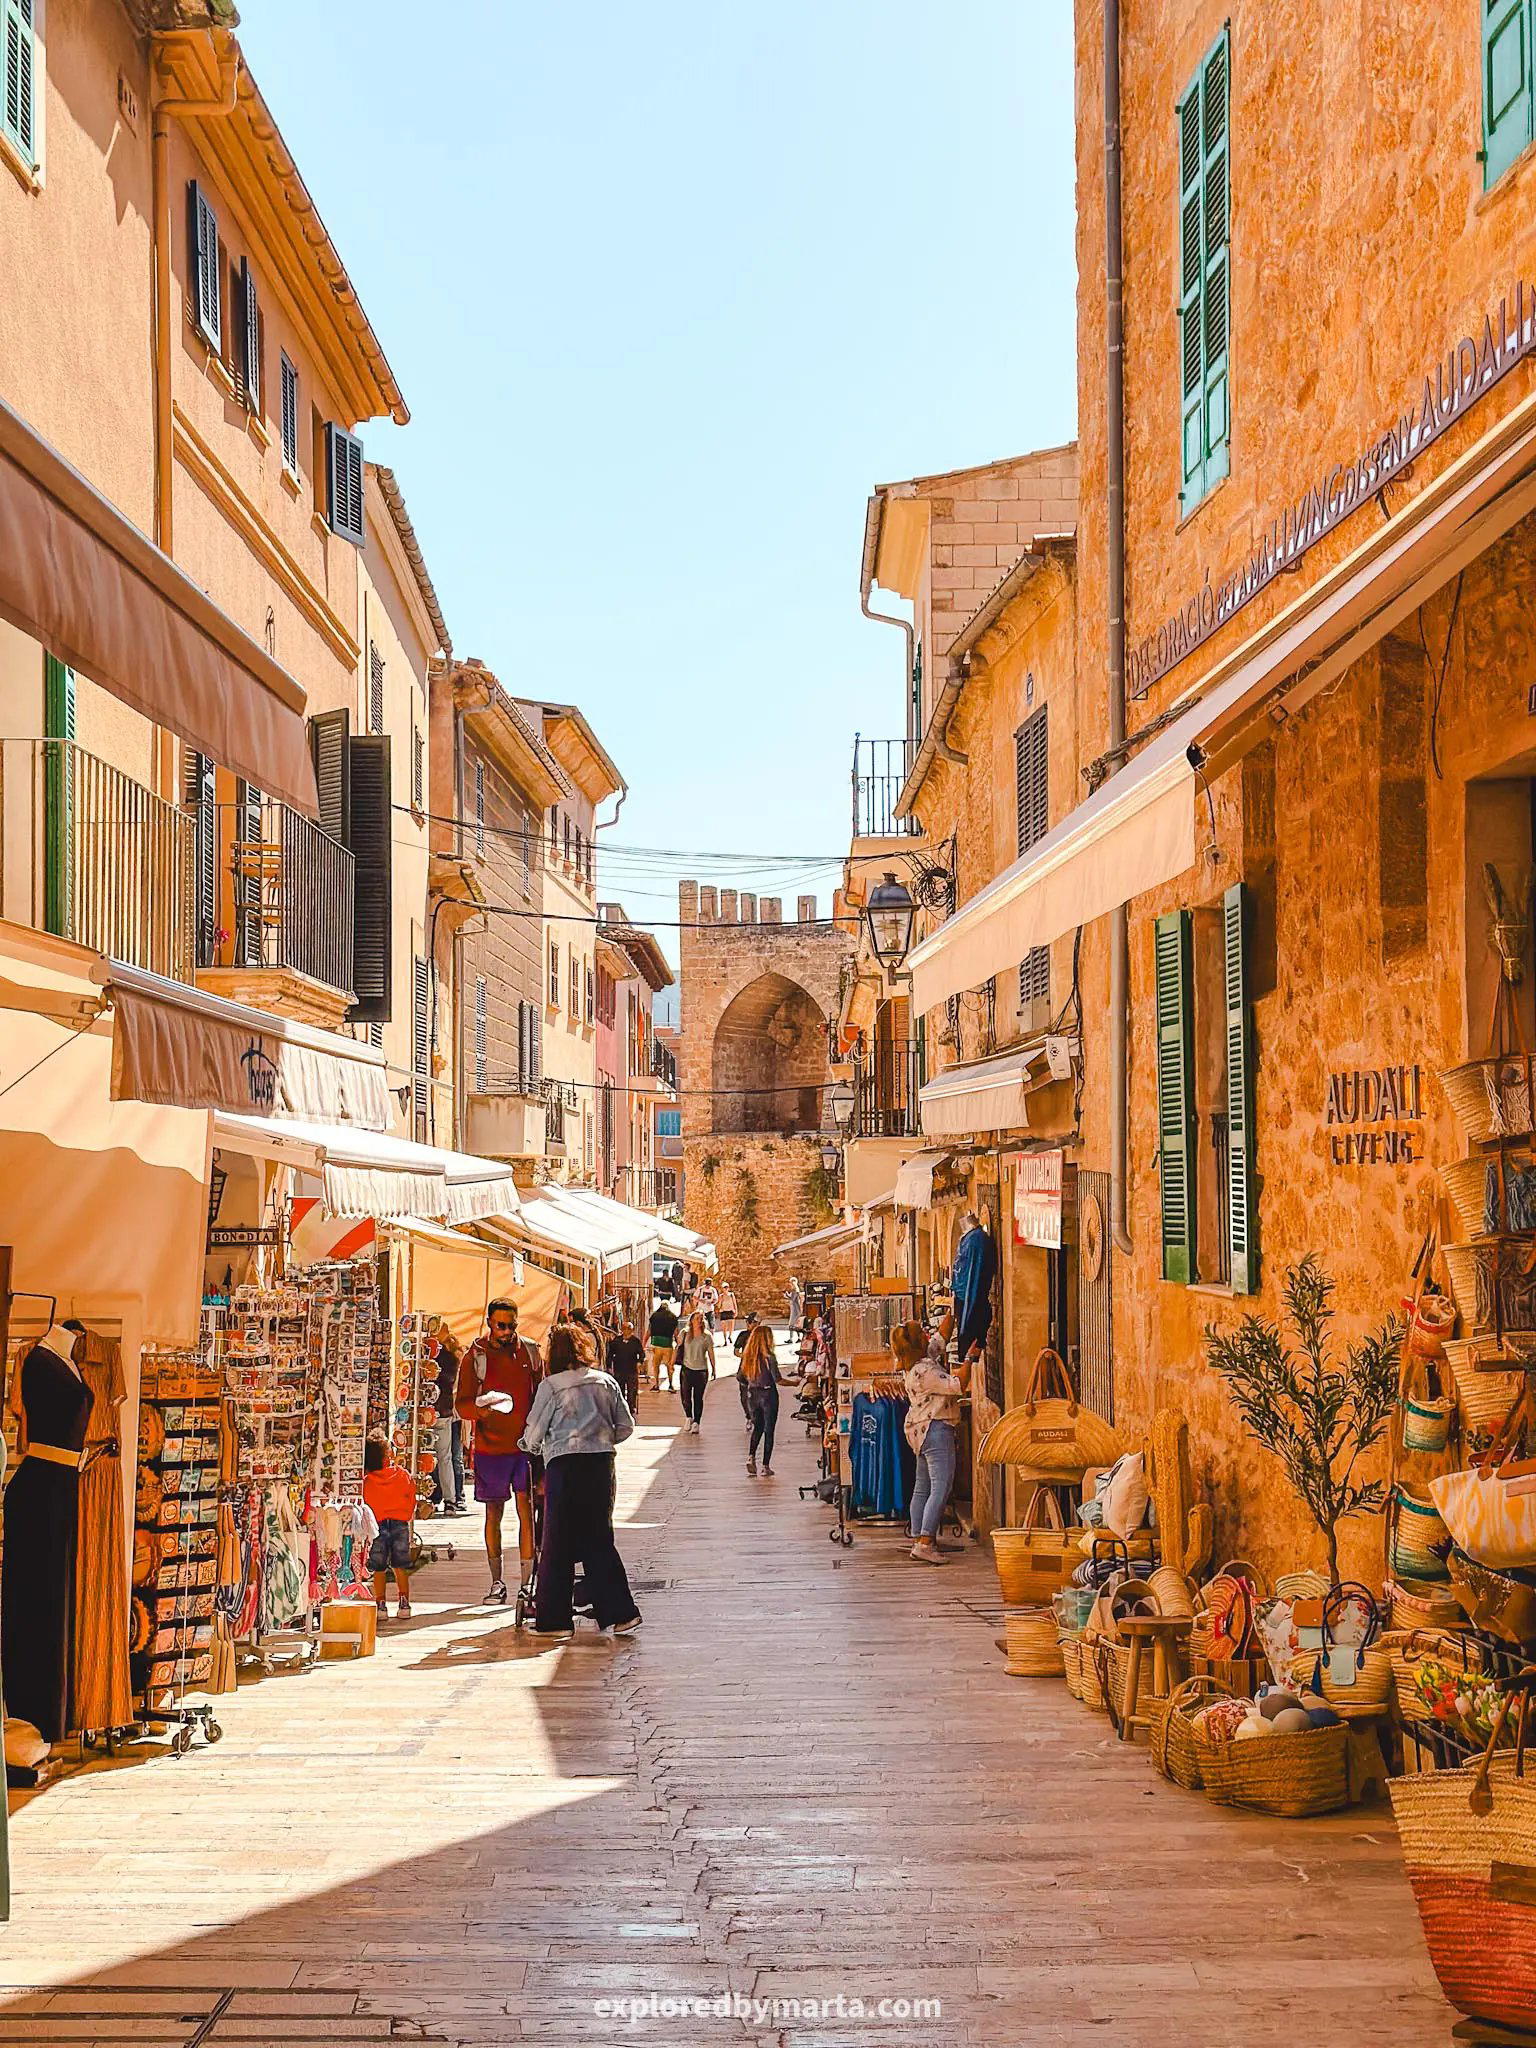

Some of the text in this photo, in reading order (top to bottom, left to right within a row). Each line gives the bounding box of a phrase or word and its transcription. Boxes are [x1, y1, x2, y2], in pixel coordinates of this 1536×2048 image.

[1272, 463, 1343, 562] LIVING
[1418, 279, 1523, 445] AUDALI
[1327, 1064, 1422, 1125] AUDALI
[1331, 1131, 1416, 1165] LIVING
[213, 1232, 237, 1242] BON
